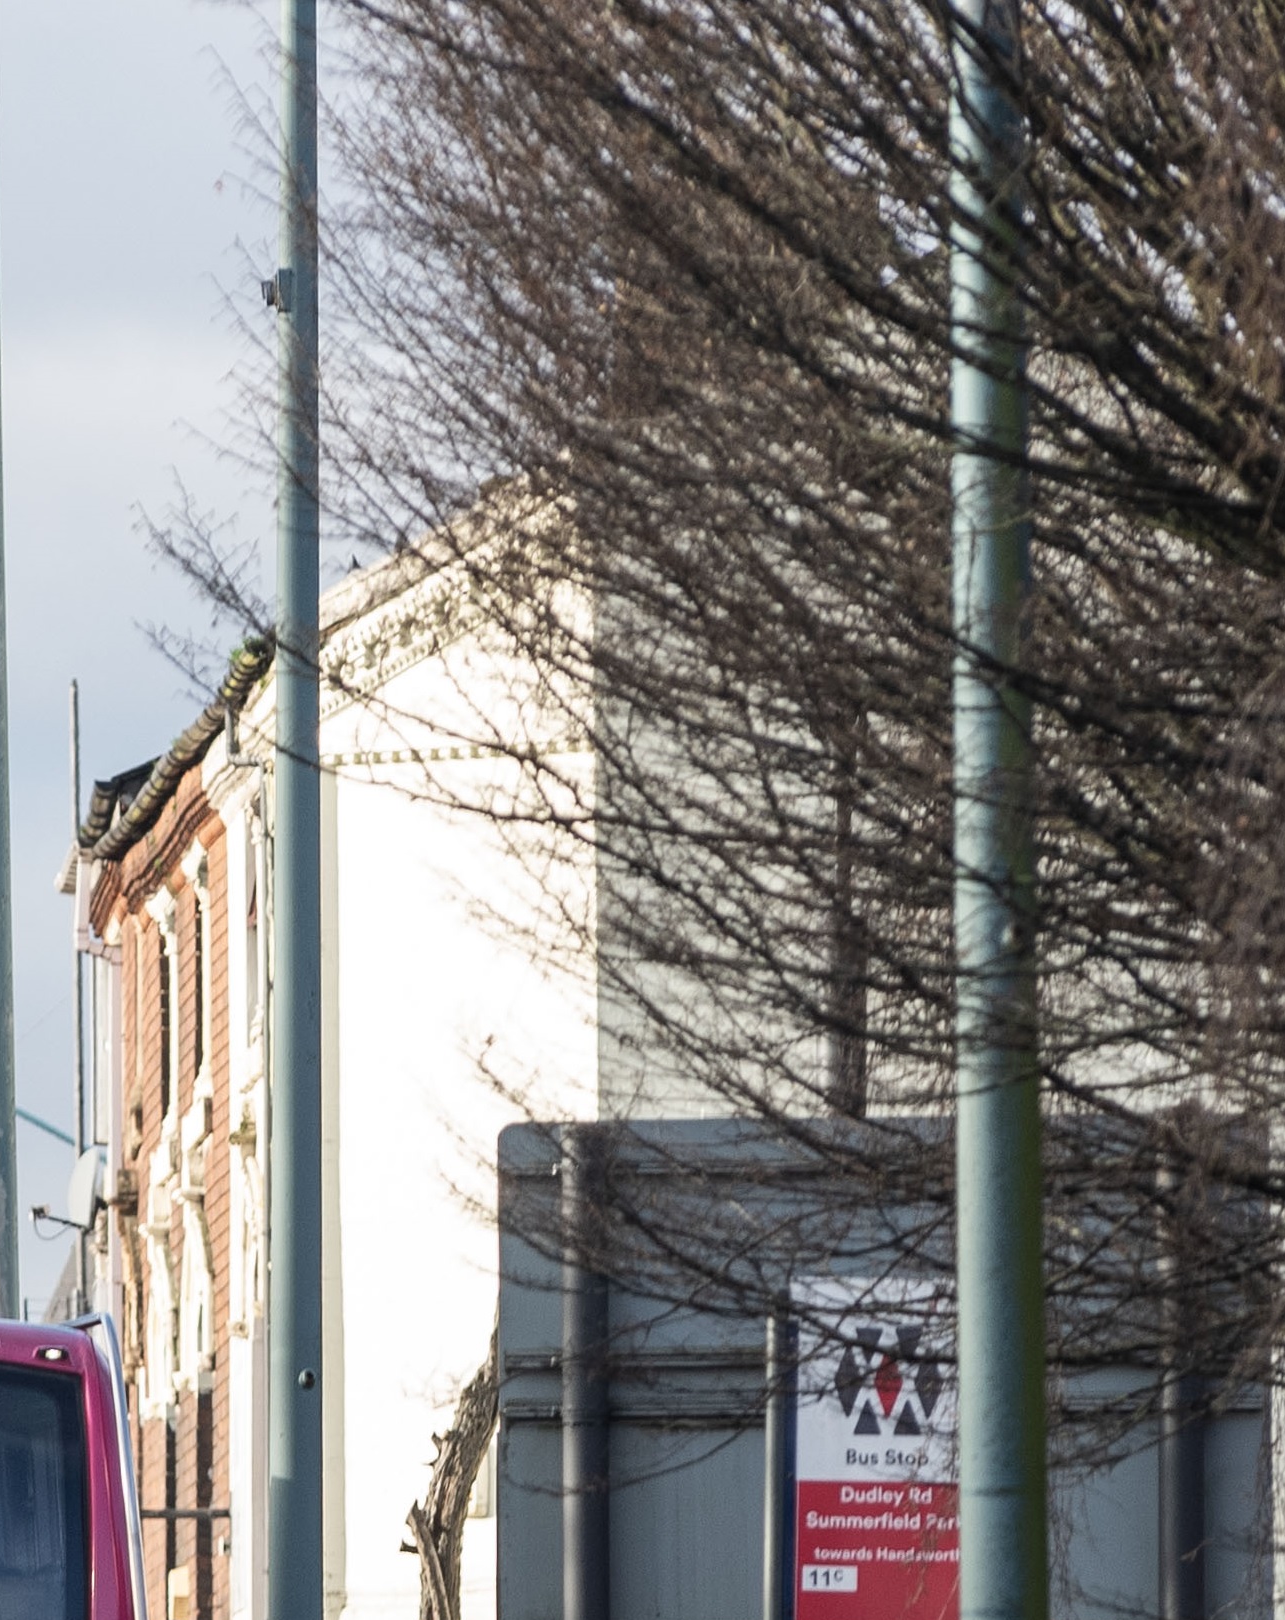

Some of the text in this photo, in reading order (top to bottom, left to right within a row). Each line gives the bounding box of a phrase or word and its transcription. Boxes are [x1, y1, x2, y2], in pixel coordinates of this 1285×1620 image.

[846, 1449, 929, 1468] Bus Stop
[840, 1485, 933, 1507] Dudley Rd
[806, 1510, 921, 1530] Summerfield
[814, 1546, 873, 1561] towards
